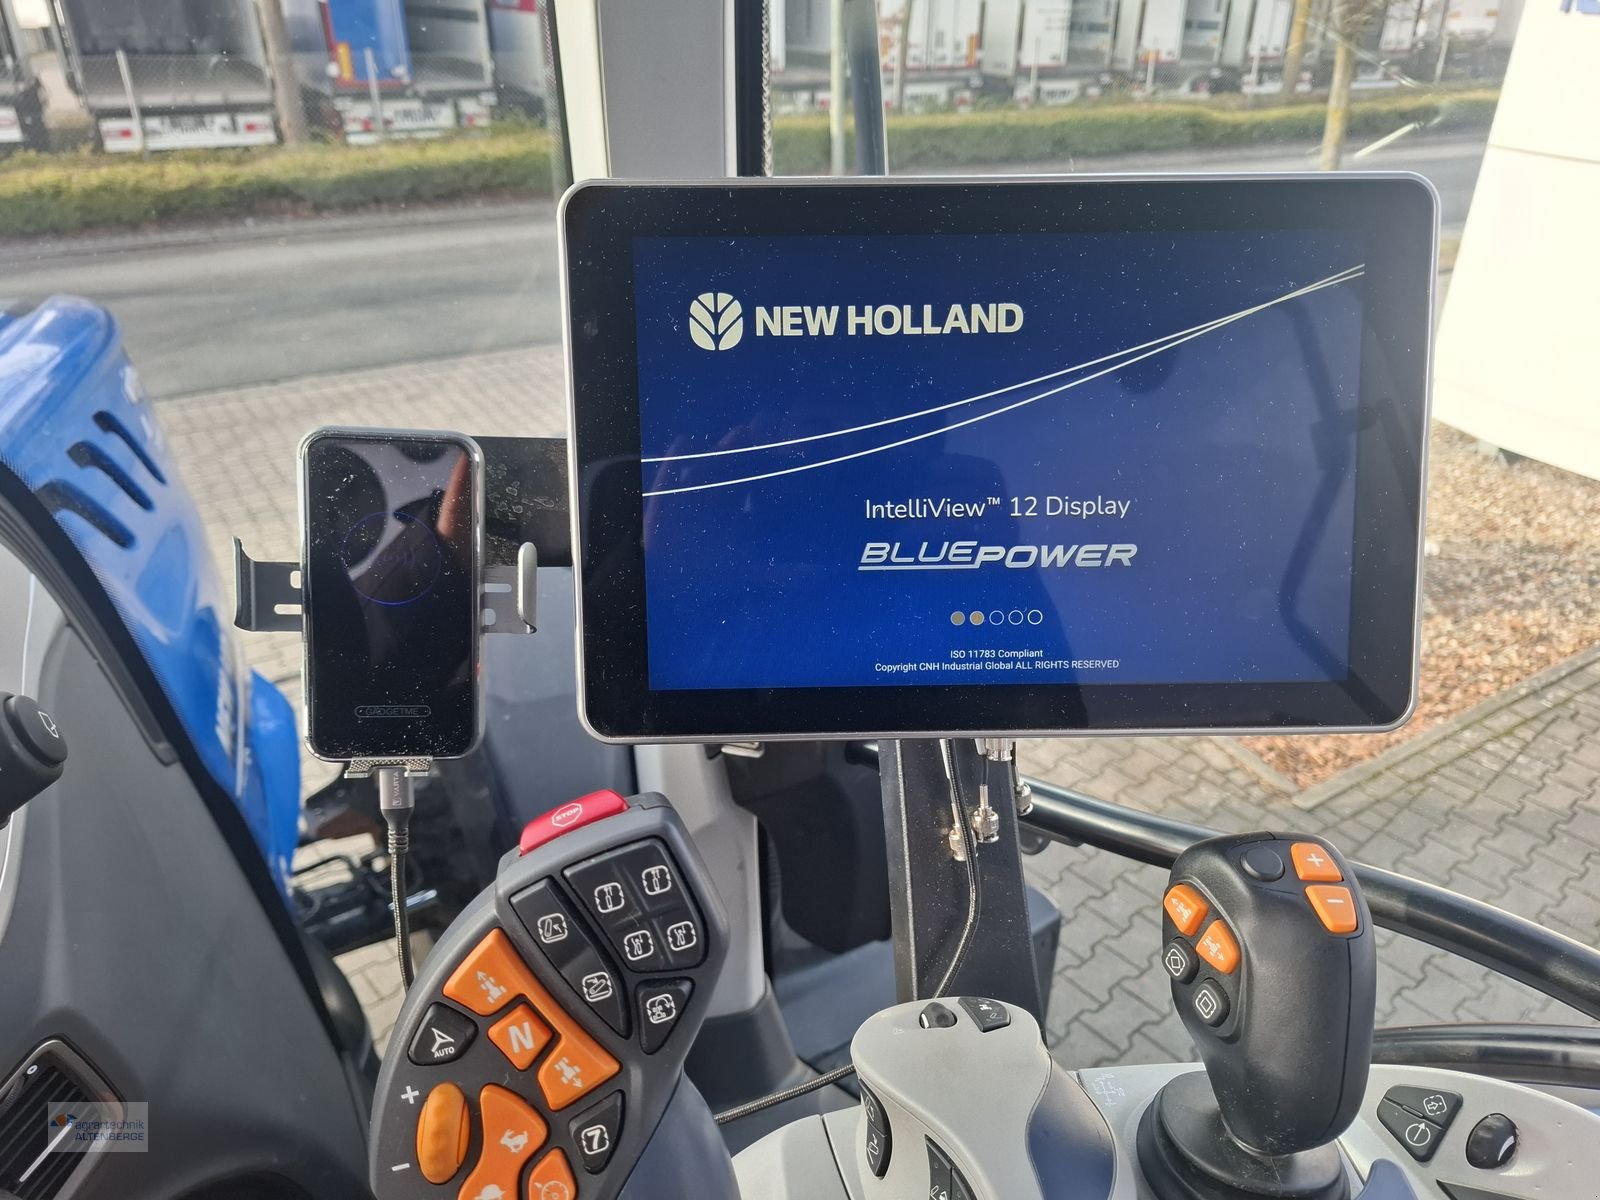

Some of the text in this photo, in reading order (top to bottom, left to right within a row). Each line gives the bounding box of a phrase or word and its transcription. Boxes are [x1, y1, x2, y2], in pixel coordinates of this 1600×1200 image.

[756, 303, 1024, 336] NEW HOLLAND
[1010, 496, 1038, 516] 12
[1046, 495, 1131, 519] Display
[950, 649, 1044, 659] ISO 11783 Compliant
[875, 660, 1120, 673] Copyright CNH Industrial Global ALL RIGHTS RESERVED
[555, 806, 579, 821] STOP
[508, 1021, 535, 1054] N
[434, 1046, 455, 1058] AUTO
[586, 1128, 601, 1150] 7
